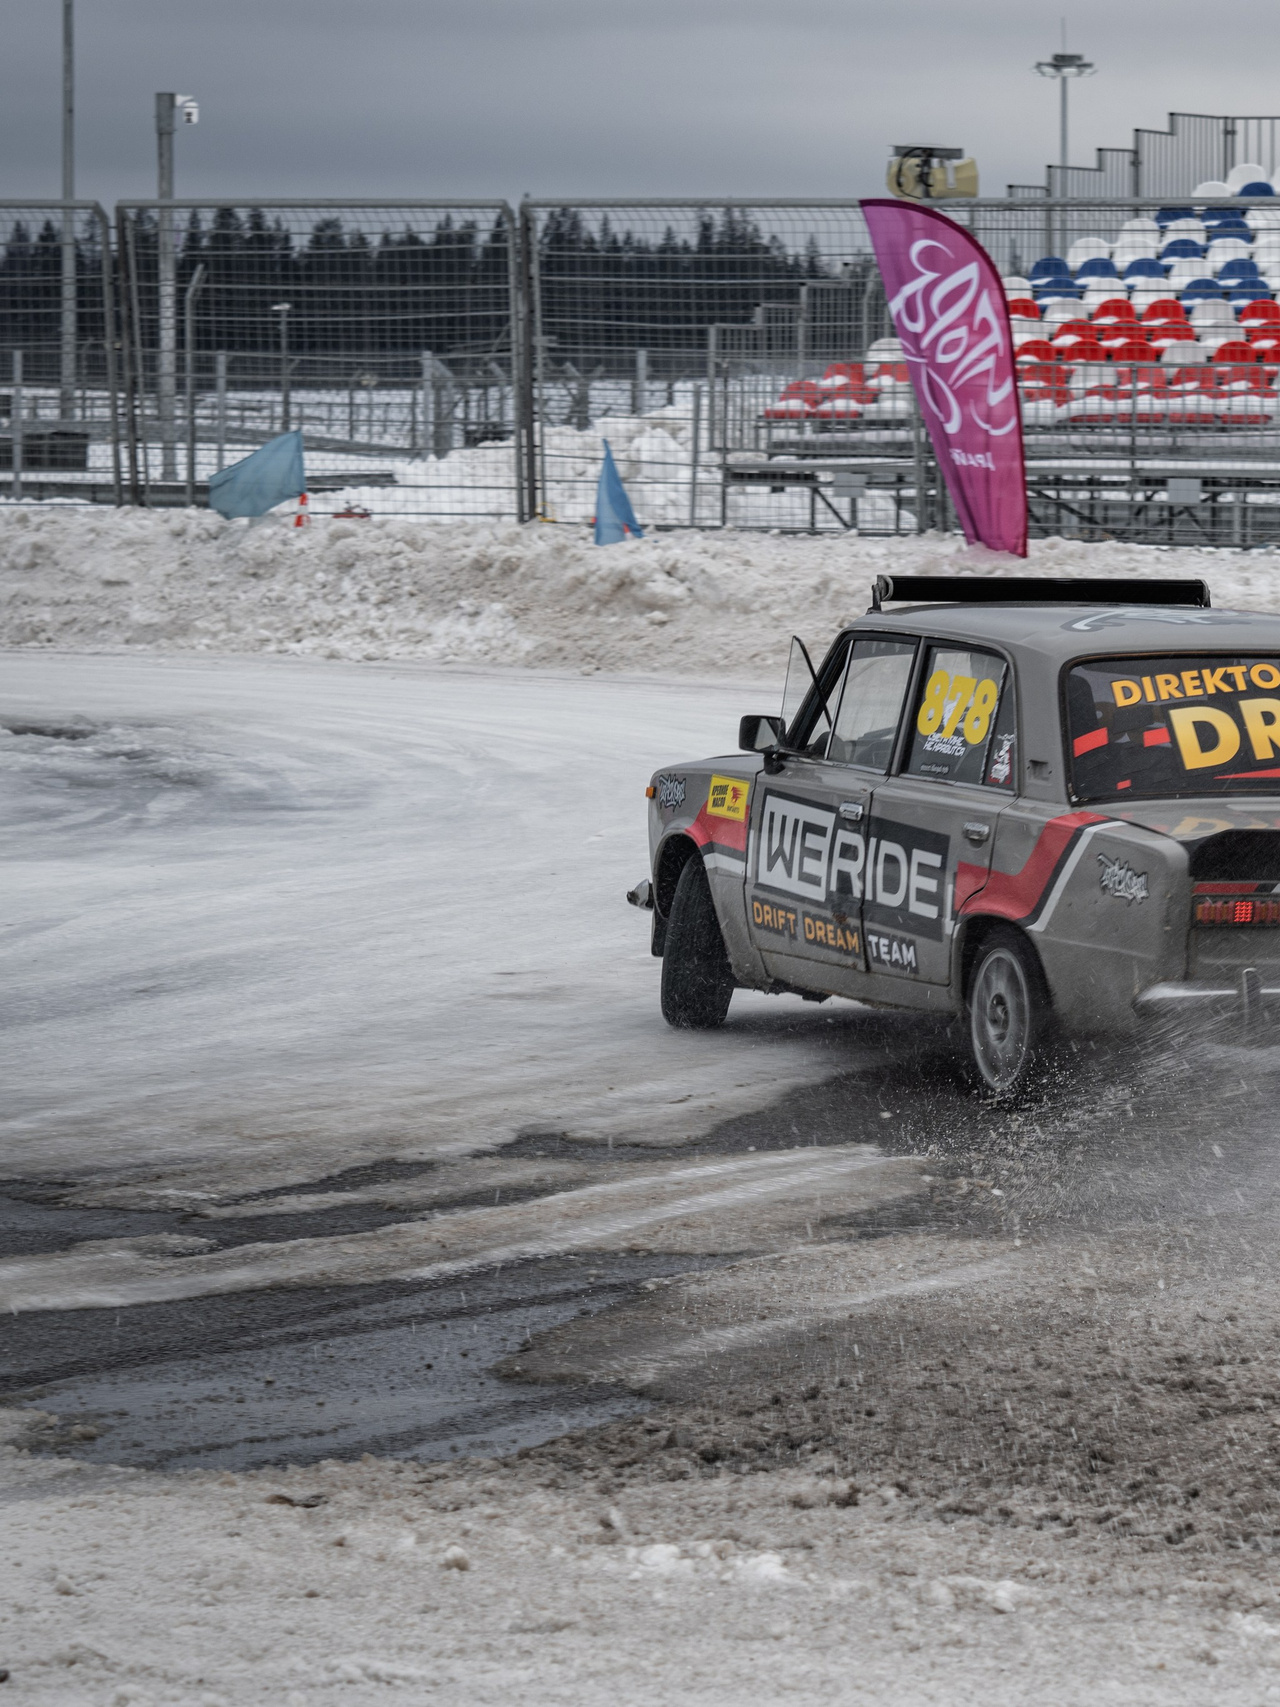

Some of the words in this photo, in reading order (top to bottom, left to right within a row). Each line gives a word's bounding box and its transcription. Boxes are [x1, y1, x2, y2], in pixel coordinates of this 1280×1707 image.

[917, 669, 998, 745] 878
[765, 810, 943, 920] WERIDE
[753, 901, 798, 935] DRIFT
[803, 916, 860, 953] DREAM
[867, 933, 917, 968] TEAM
